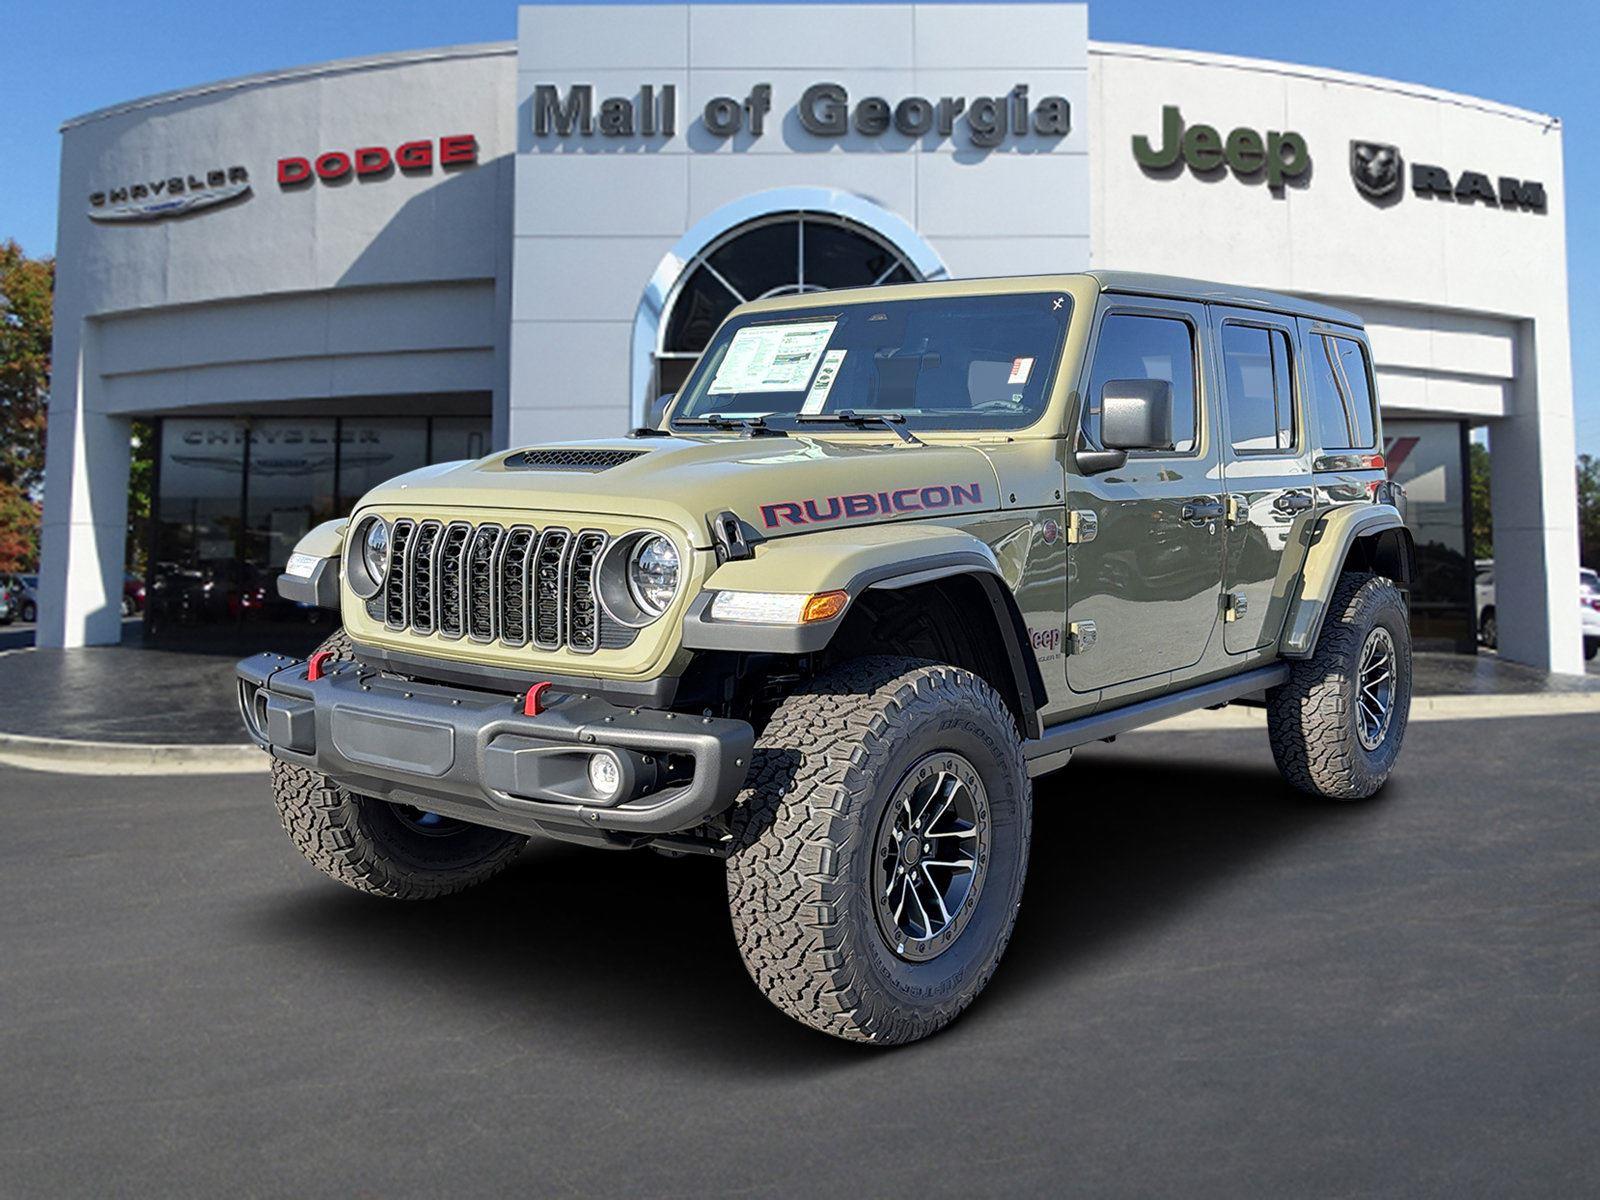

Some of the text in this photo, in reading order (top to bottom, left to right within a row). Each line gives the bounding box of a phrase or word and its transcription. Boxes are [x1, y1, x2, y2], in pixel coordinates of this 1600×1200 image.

[533, 83, 1072, 148] Mall of Georgia
[277, 134, 477, 187] DODGE
[1131, 105, 1309, 189] Jeep
[89, 166, 249, 207] CHRYSLER
[1411, 162, 1547, 212] RAM
[183, 429, 382, 445] CHRYSLER
[759, 482, 983, 530] RUBICON
